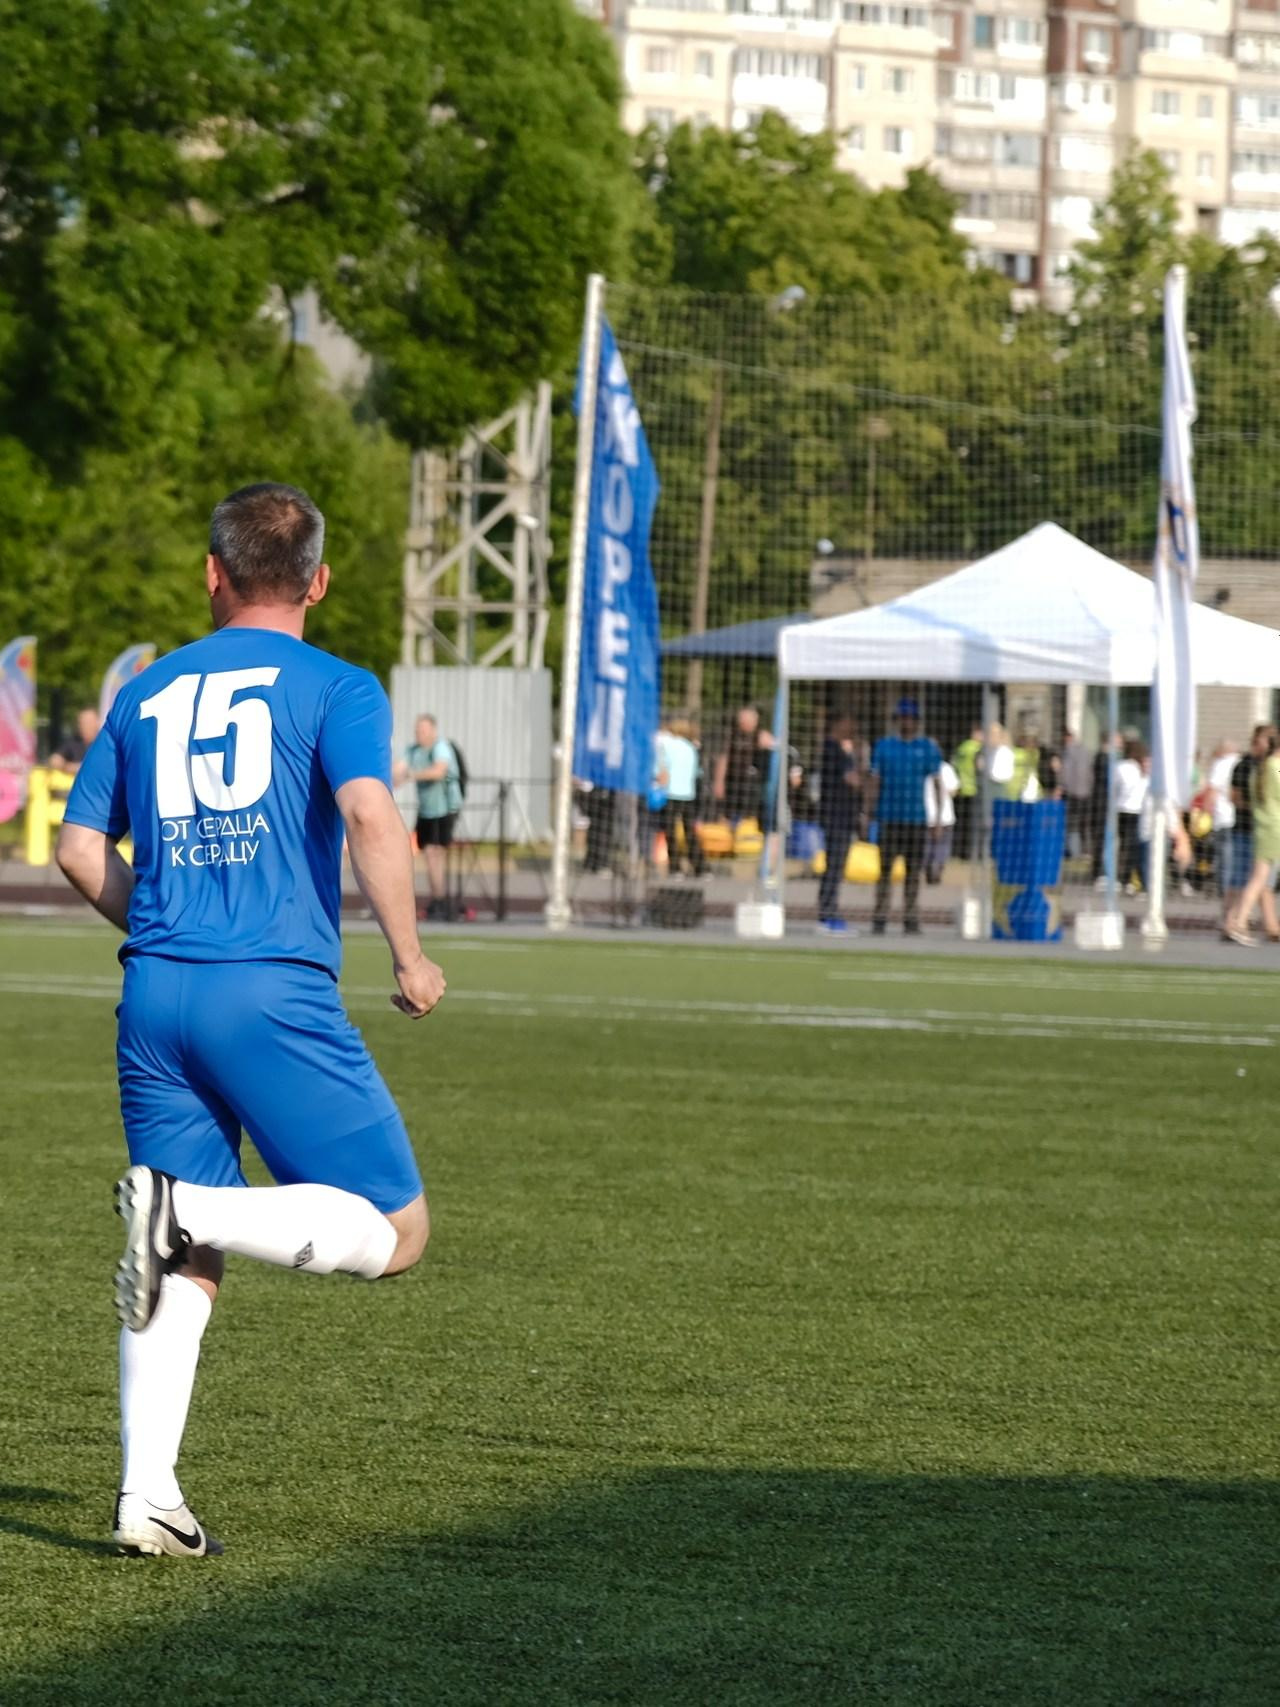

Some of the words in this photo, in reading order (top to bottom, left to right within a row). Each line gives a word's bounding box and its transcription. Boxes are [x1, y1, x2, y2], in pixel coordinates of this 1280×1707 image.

[586, 349, 641, 769] ЖОРЕЦ
[140, 667, 280, 818] 15
[161, 819, 191, 842] ОТ
[196, 812, 271, 839] СЕРДЦА
[171, 845, 186, 867] К
[189, 839, 260, 867] СЕРДЦУ
